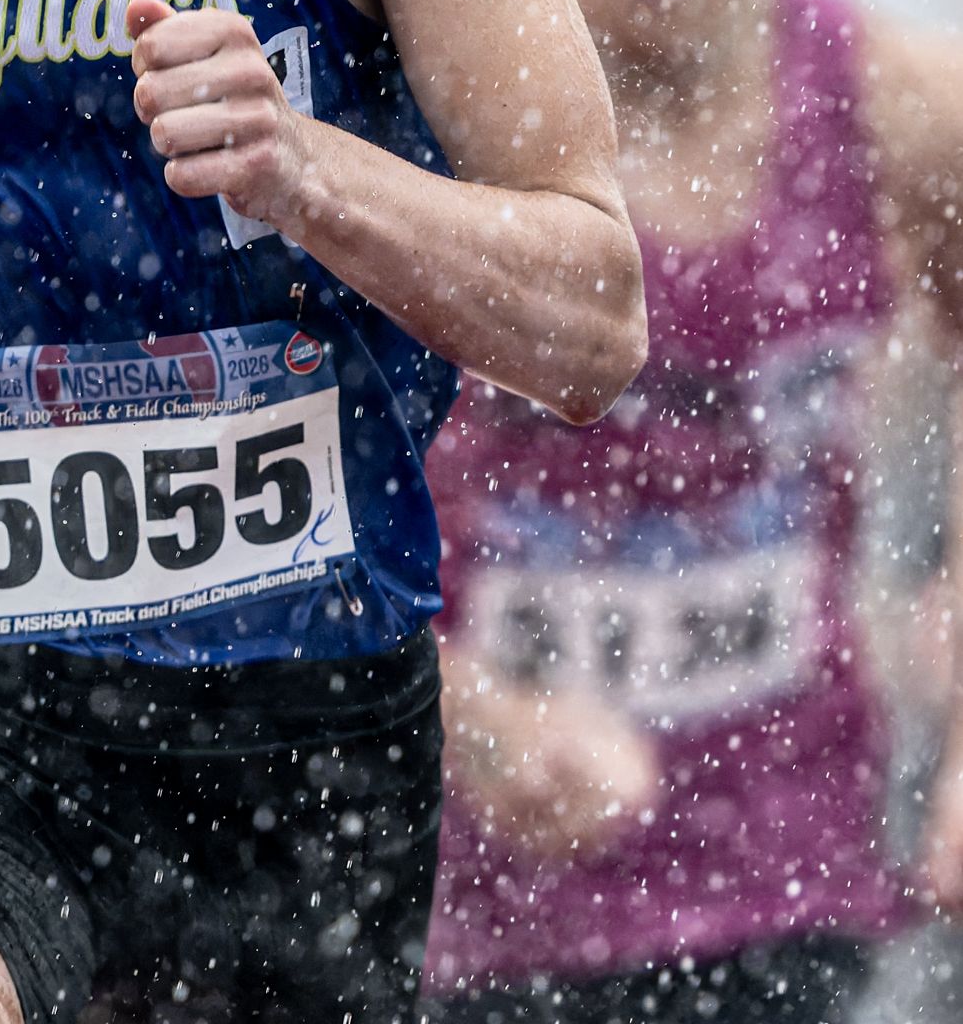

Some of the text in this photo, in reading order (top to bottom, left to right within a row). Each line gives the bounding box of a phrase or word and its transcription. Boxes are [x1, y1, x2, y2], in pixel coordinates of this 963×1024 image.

[60, 359, 187, 398] MSHSAA
[227, 353, 270, 382] 2026
[61, 403, 103, 424] Track
[106, 403, 122, 420] &
[125, 397, 159, 418] Field
[162, 390, 267, 420] Championships
[13, 611, 87, 633] MSHSAA
[89, 606, 136, 625] Track
[138, 601, 169, 621] and
[171, 589, 208, 614] Field
[210, 561, 327, 604] Championships
